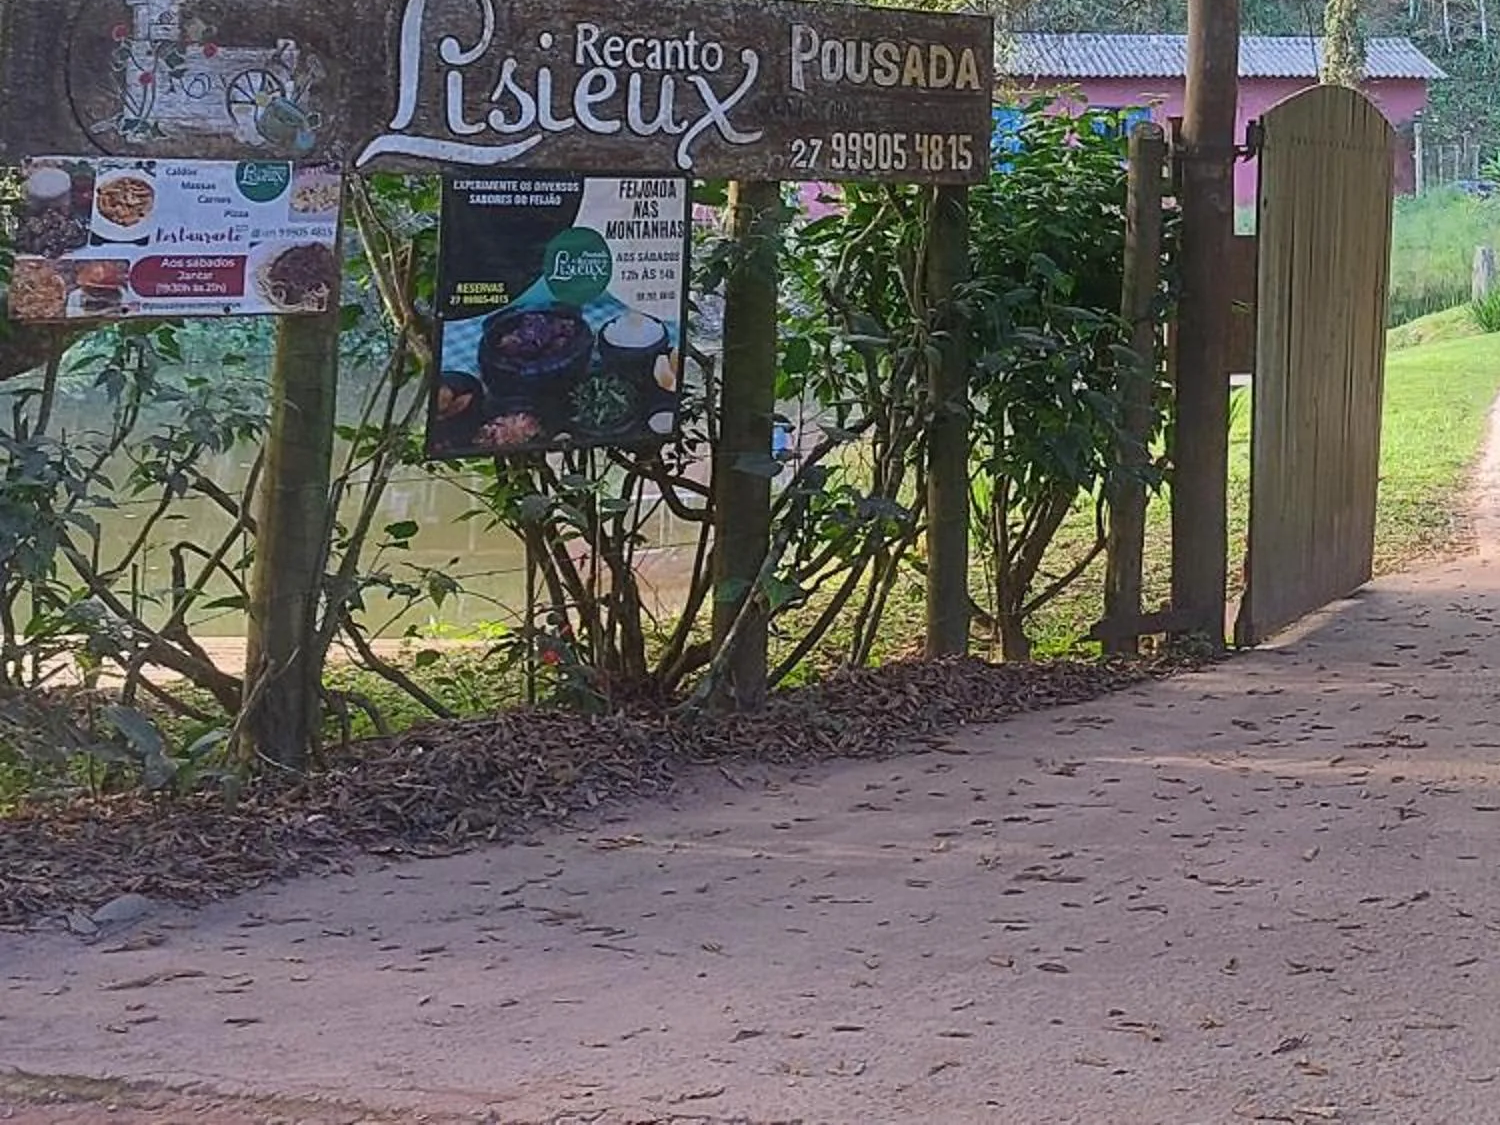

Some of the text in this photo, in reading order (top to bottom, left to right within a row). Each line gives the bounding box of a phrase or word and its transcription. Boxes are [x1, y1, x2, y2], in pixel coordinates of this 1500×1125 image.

[575, 22, 723, 72] Recanto
[791, 24, 983, 92] POUSADA
[791, 132, 973, 171] 27 99905 4815
[453, 180, 579, 192] EXPERIMENTE OS DIVERSOS
[619, 180, 676, 199] FEIJOADA
[469, 194, 513, 204] SABORES
[529, 193, 561, 206] FEIJÃO
[633, 200, 659, 218] NAS
[606, 220, 684, 240] MONTANHAS
[457, 282, 505, 293] RESERVAS
